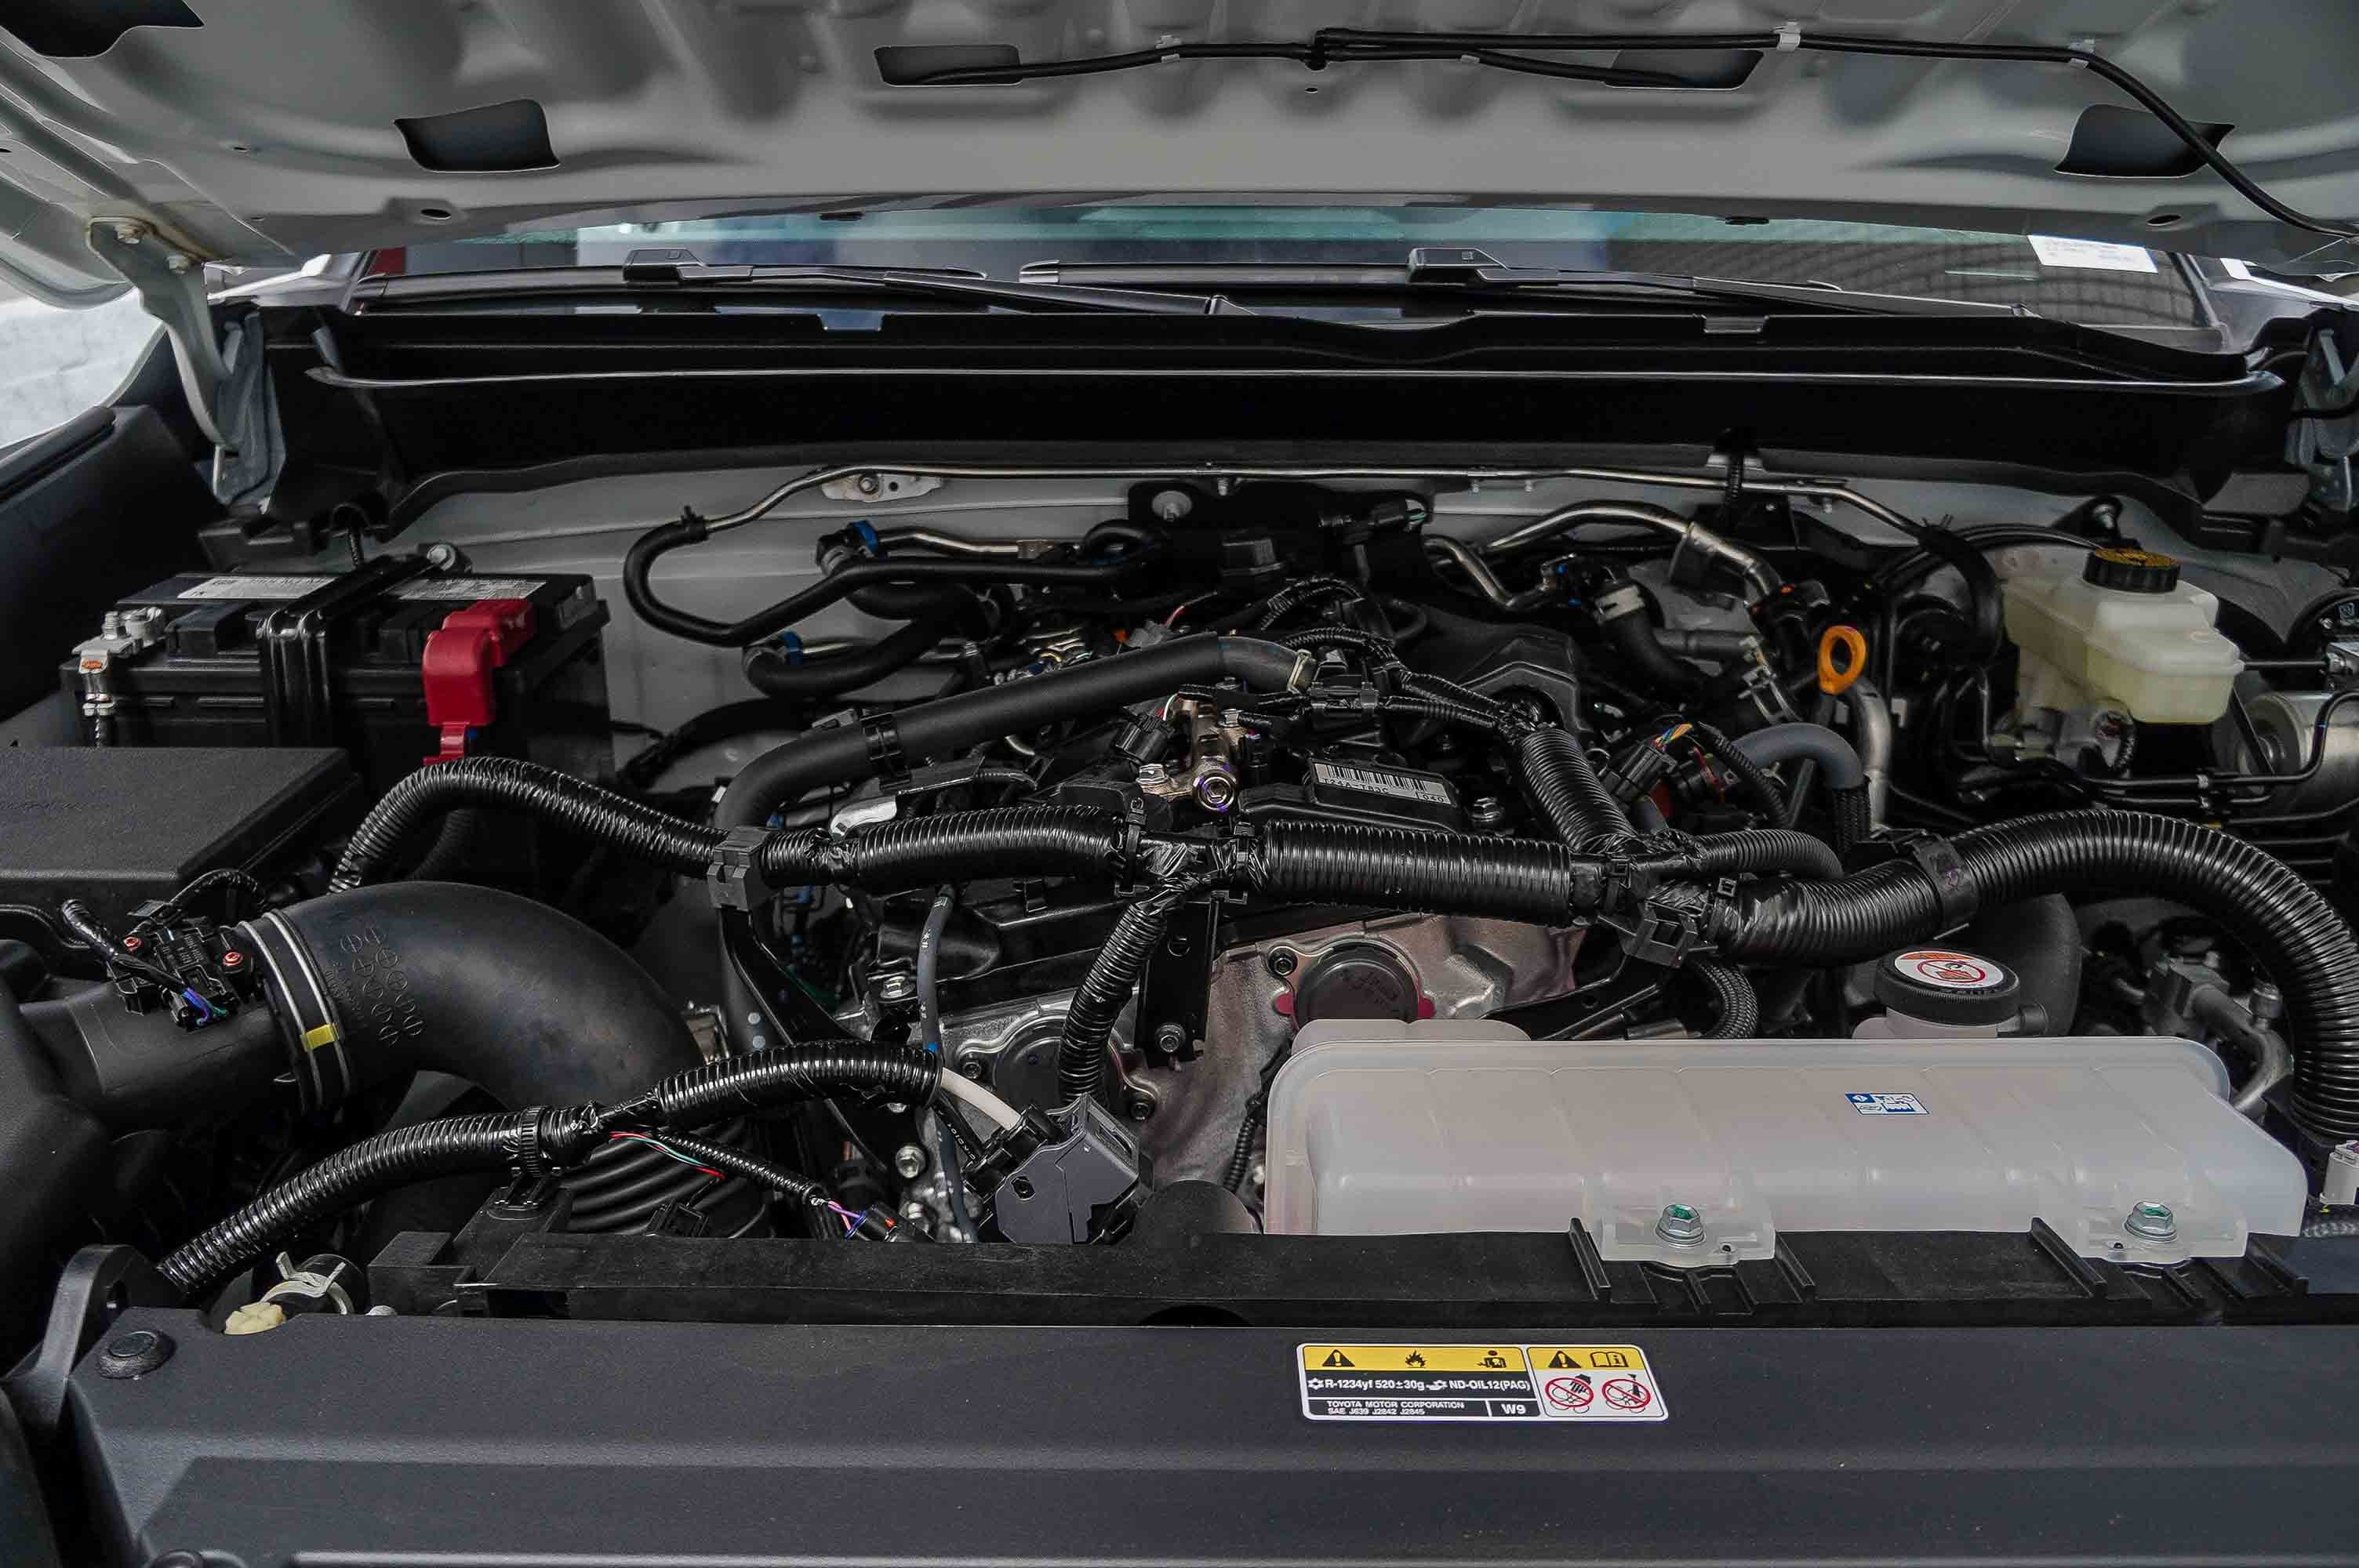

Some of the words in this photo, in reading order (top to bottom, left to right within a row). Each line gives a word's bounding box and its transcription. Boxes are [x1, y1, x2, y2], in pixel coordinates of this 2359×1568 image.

[1375, 1380, 1424, 1391] 520±30g
[1449, 1380, 1530, 1391] ND-OIL12(PAG)
[1501, 1403, 1525, 1414] W9
